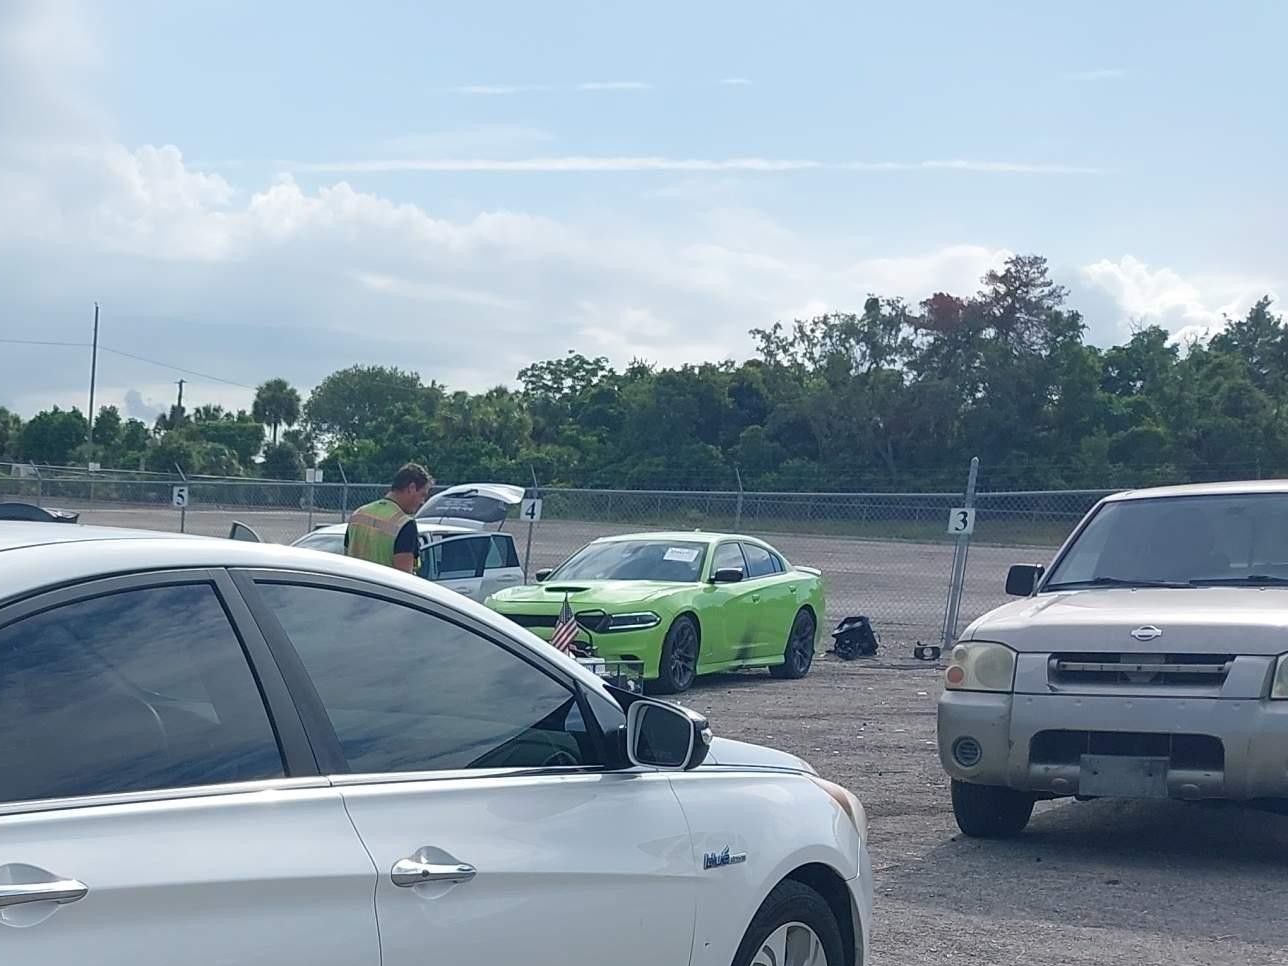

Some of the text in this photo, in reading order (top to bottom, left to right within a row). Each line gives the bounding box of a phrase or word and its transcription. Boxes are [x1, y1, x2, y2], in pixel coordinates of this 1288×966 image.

[176, 488, 185, 505] 5
[525, 501, 536, 520] 4
[954, 511, 969, 532] 3
